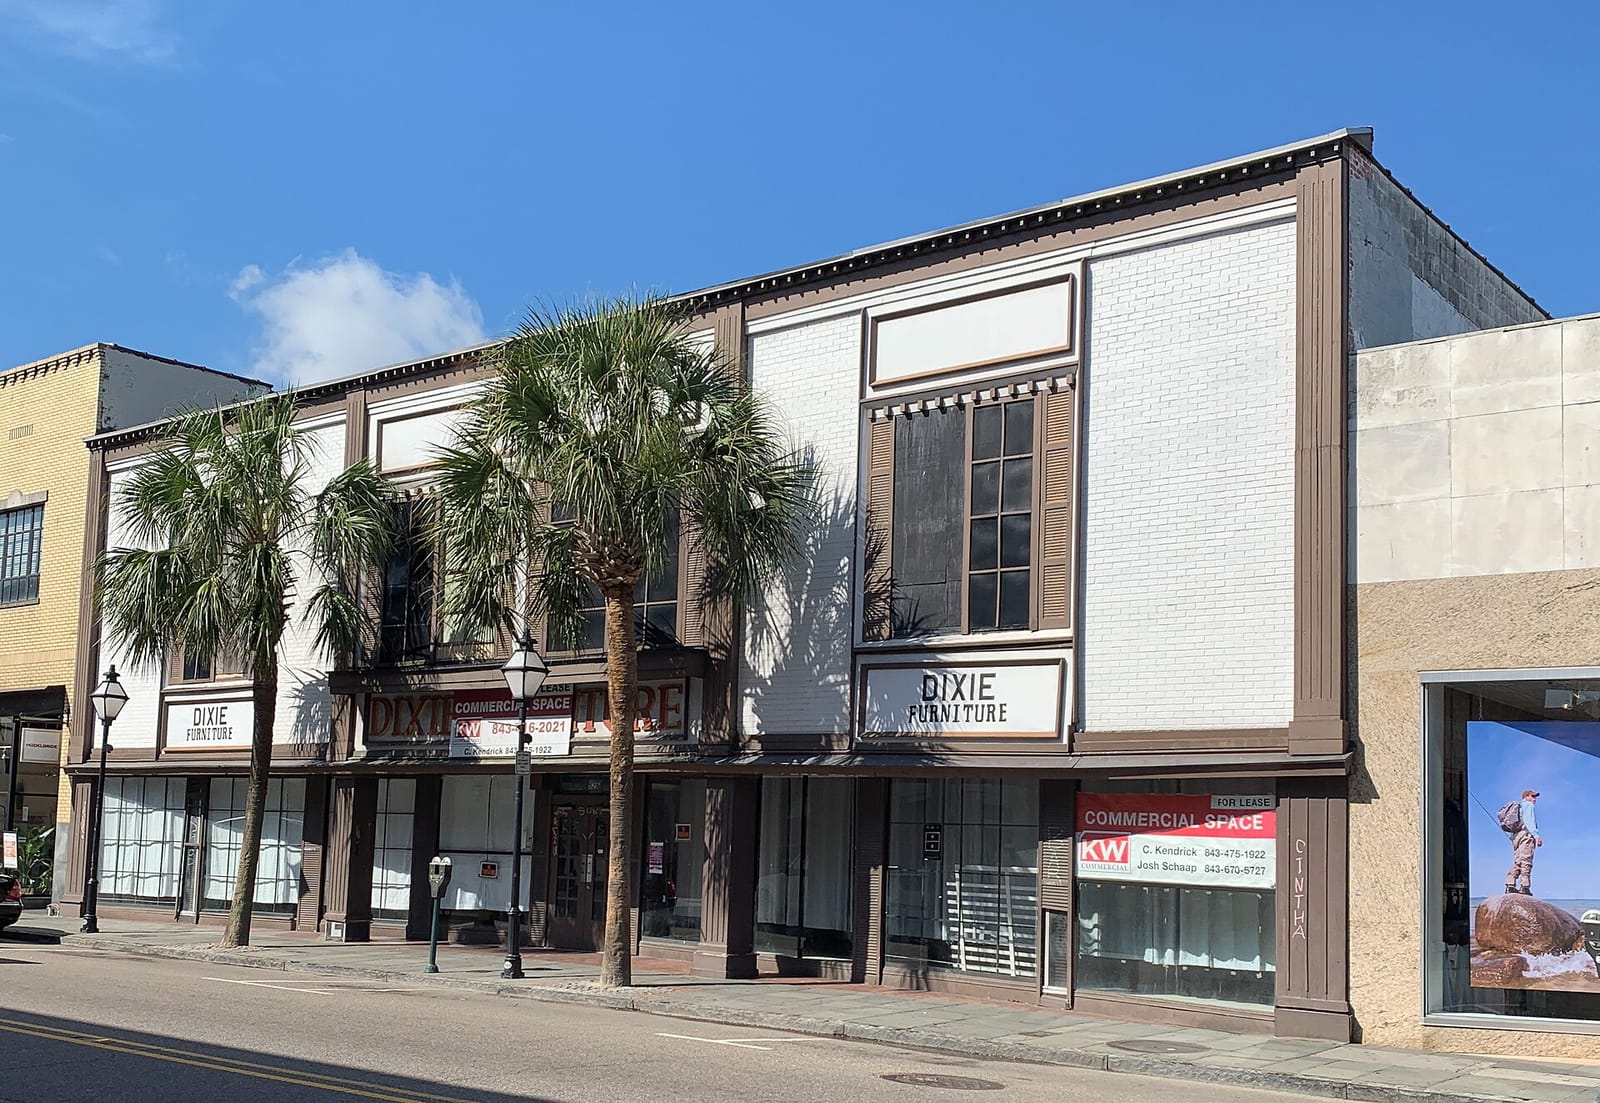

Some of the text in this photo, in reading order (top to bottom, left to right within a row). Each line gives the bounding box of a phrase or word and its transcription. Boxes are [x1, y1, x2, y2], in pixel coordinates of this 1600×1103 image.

[540, 684, 571, 693] LEASE
[921, 673, 996, 702] DIXIE
[455, 697, 570, 714] COMMERCIA SPACE
[908, 703, 1008, 723] FURNITURE
[193, 706, 228, 727] DIXIE
[186, 726, 233, 742] FURNITURE
[455, 722, 481, 737] KW
[1217, 798, 1271, 807] FOR LEASE
[1085, 810, 1264, 830] COMMERCIAL SPACE
[1081, 839, 1128, 861] KW
[1142, 845, 1266, 859] C. Kendrick 843-475-1922
[1081, 862, 1128, 872] COMMERCIAL
[1137, 860, 1266, 875] Josh Schaap 843-670-5727
